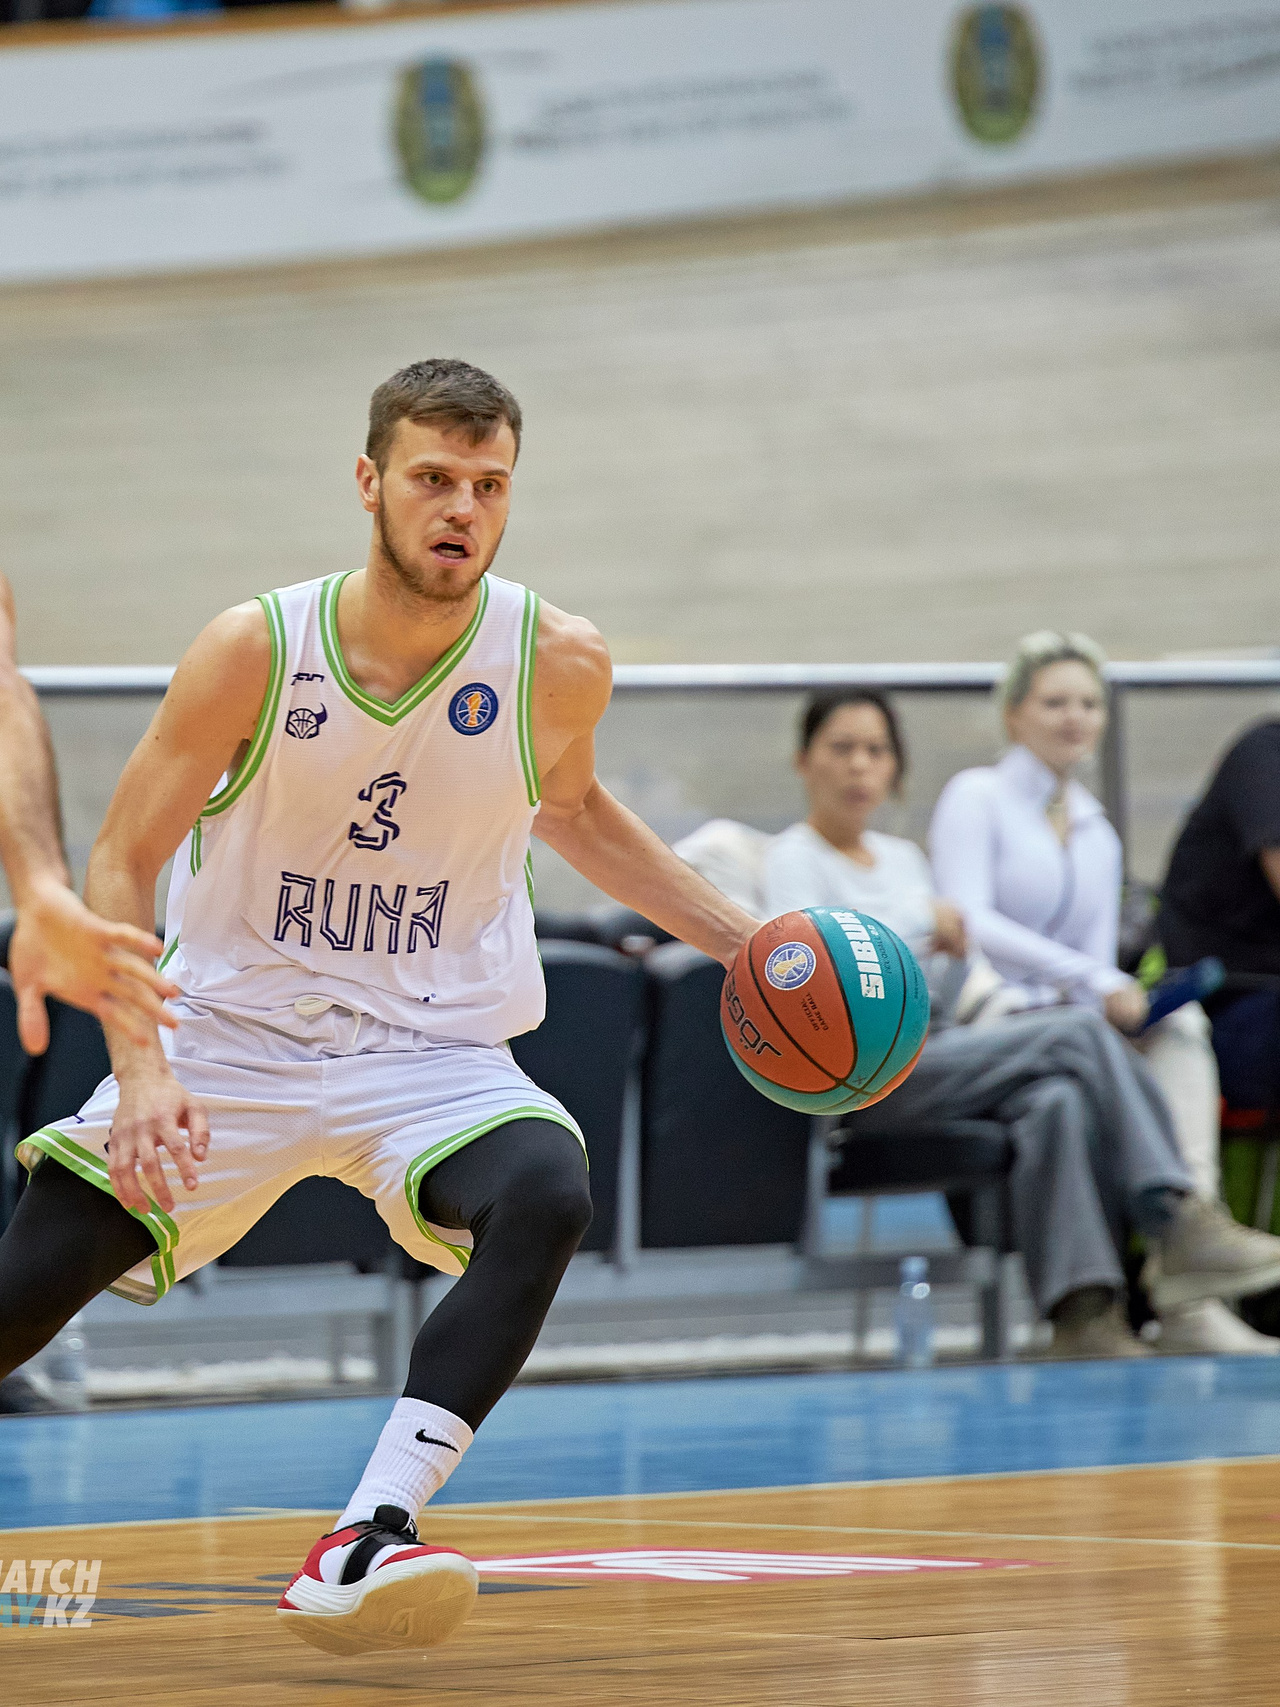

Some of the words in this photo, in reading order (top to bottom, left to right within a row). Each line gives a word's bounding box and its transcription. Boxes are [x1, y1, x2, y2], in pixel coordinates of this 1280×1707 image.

[274, 871, 449, 954] RUNA
[830, 911, 885, 999] SIBUR
[801, 1000, 820, 1032] OFFICIAL
[815, 1009, 829, 1031] GAME
